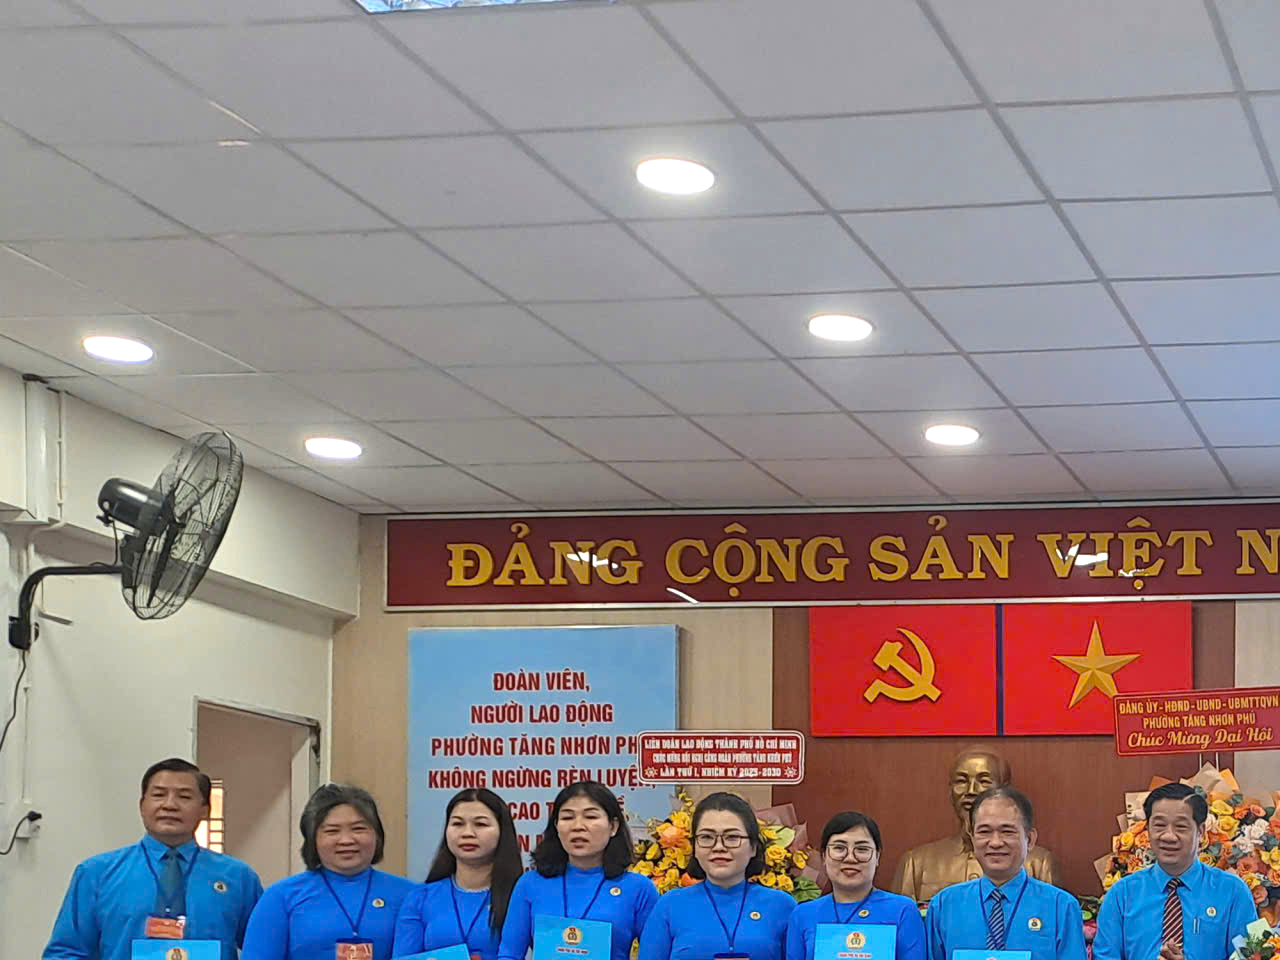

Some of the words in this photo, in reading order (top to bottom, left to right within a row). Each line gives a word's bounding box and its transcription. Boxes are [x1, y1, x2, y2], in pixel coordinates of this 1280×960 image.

[446, 522, 643, 587] ĐẢNG
[665, 521, 850, 598] CỘNG
[868, 514, 1013, 581] SẢN
[1037, 516, 1213, 590] VIỆT
[493, 668, 540, 691] ĐOÀN
[546, 668, 590, 692] VIÊN,
[471, 700, 523, 724] NGƯỜI
[530, 705, 560, 723] LAO
[566, 700, 613, 726] ĐỘNG
[1143, 714, 1180, 729] PHƯỜNG
[431, 736, 504, 756] PHƯỜNG
[510, 736, 554, 755] TĂNG
[560, 734, 610, 755] NHƠN
[616, 735, 637, 755] PH
[1128, 733, 1164, 747] Chúc
[1167, 731, 1211, 749] Mừng
[429, 766, 486, 788] KHÔNG
[492, 766, 551, 788] NGỪNG
[557, 765, 591, 788] RÈN
[597, 764, 656, 791] LUYỆ,
[508, 802, 540, 820] CAO
